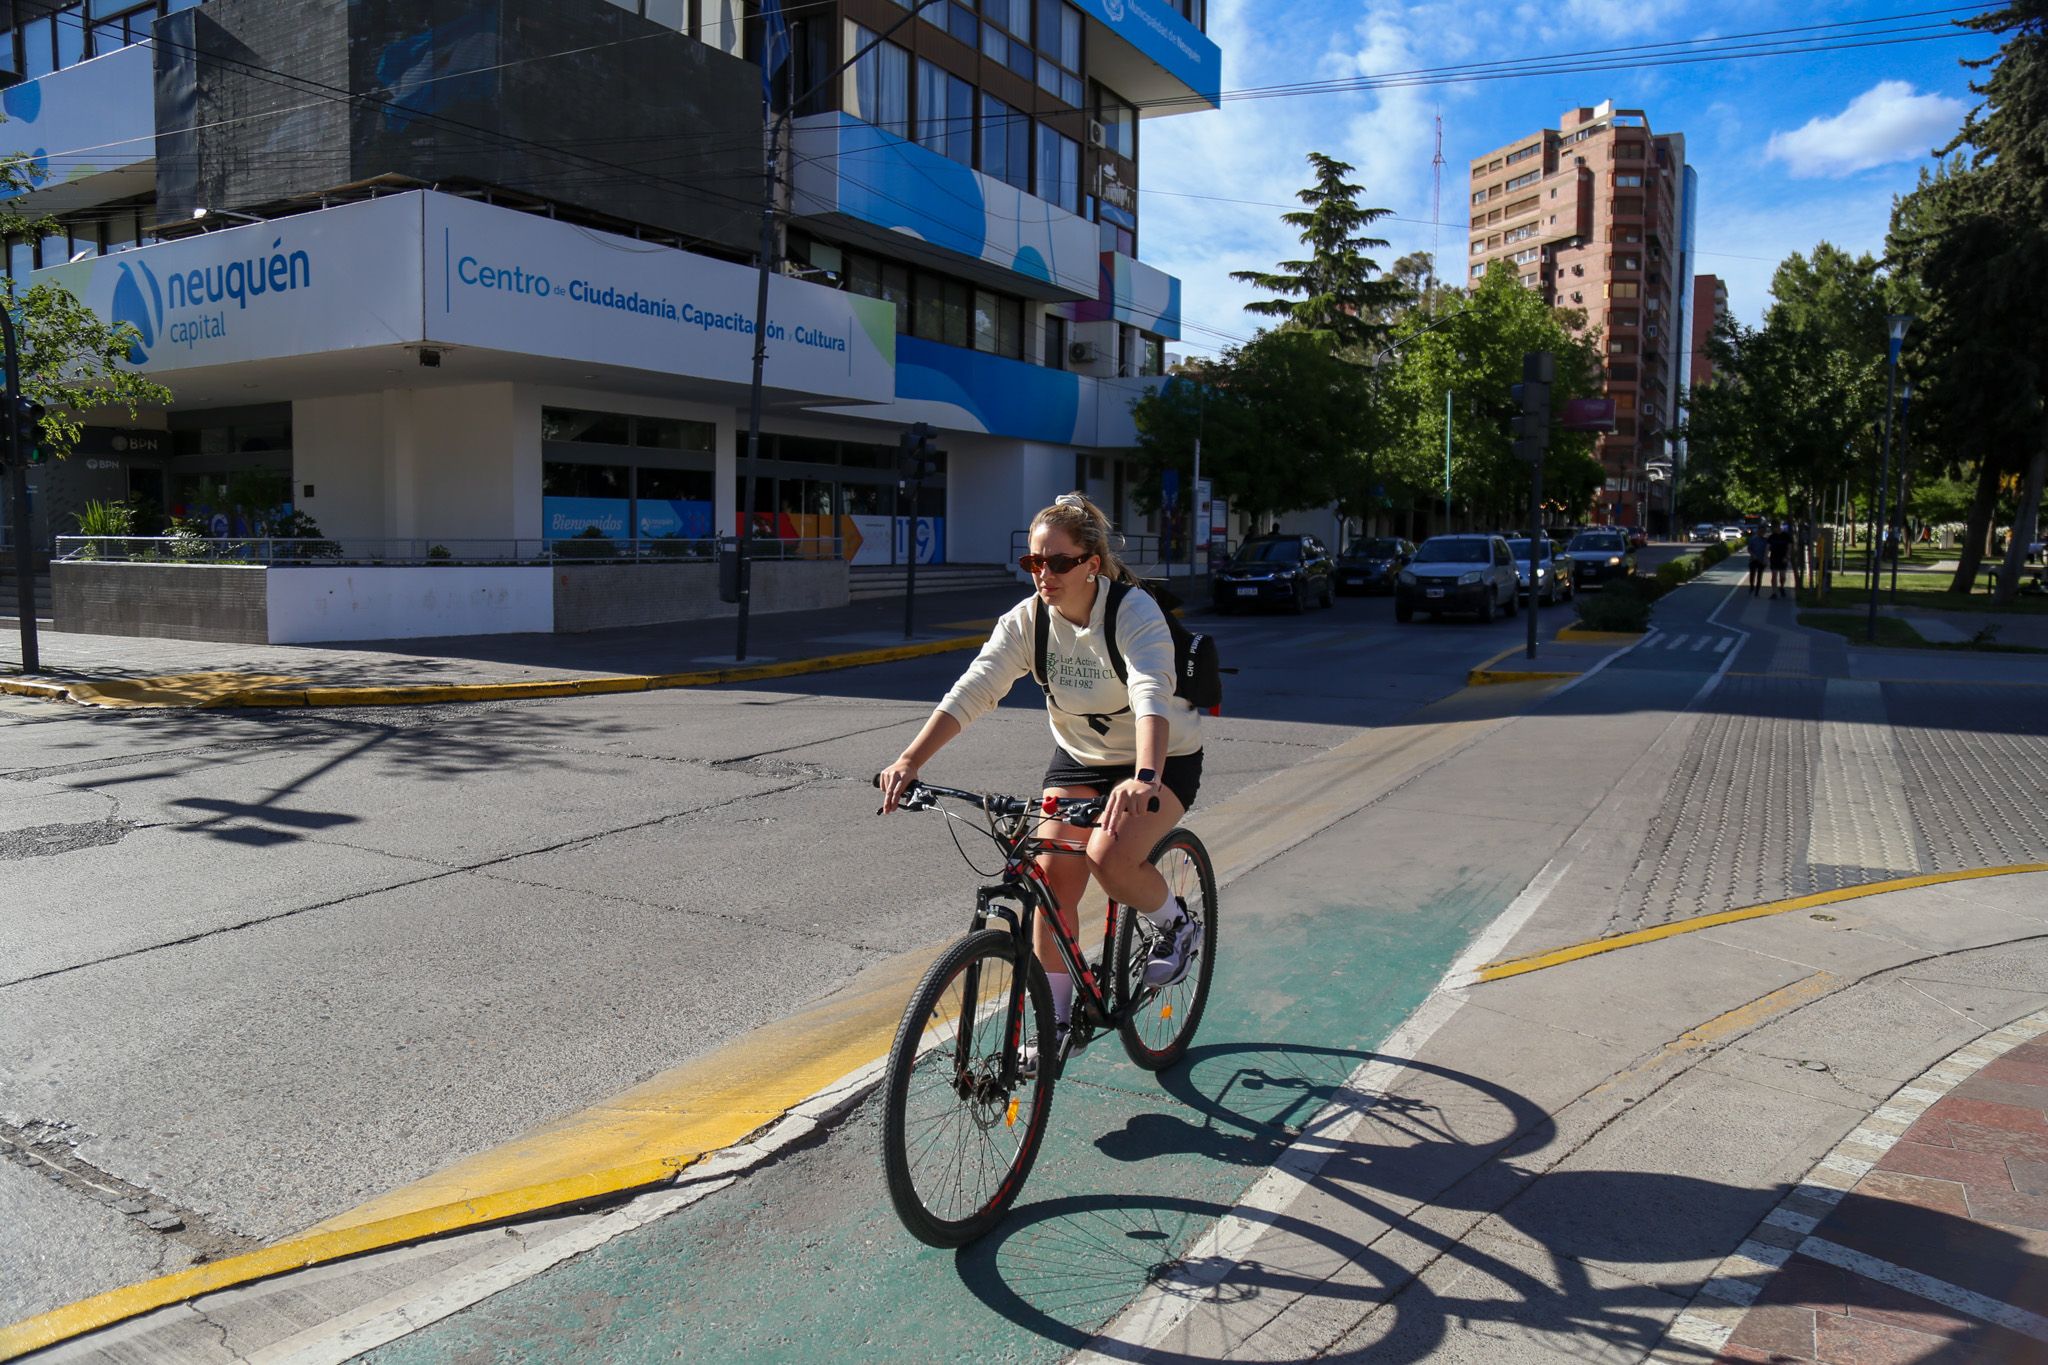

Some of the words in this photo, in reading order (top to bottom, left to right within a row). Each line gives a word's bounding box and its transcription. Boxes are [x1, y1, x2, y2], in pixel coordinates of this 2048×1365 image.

[168, 236, 310, 310] neuquén
[458, 256, 550, 297] Centro
[553, 285, 566, 296] de
[569, 280, 680, 323] Ciudadanía,
[682, 303, 785, 341] Capacitaón
[795, 326, 846, 352] Cultura
[170, 311, 226, 350] capital
[99, 460, 120, 469] BPN
[551, 512, 623, 530] Bienvenidos
[1060, 665, 1100, 679] HEALTH
[1102, 669, 1117, 680] CL
[1074, 679, 1093, 690] 1982
